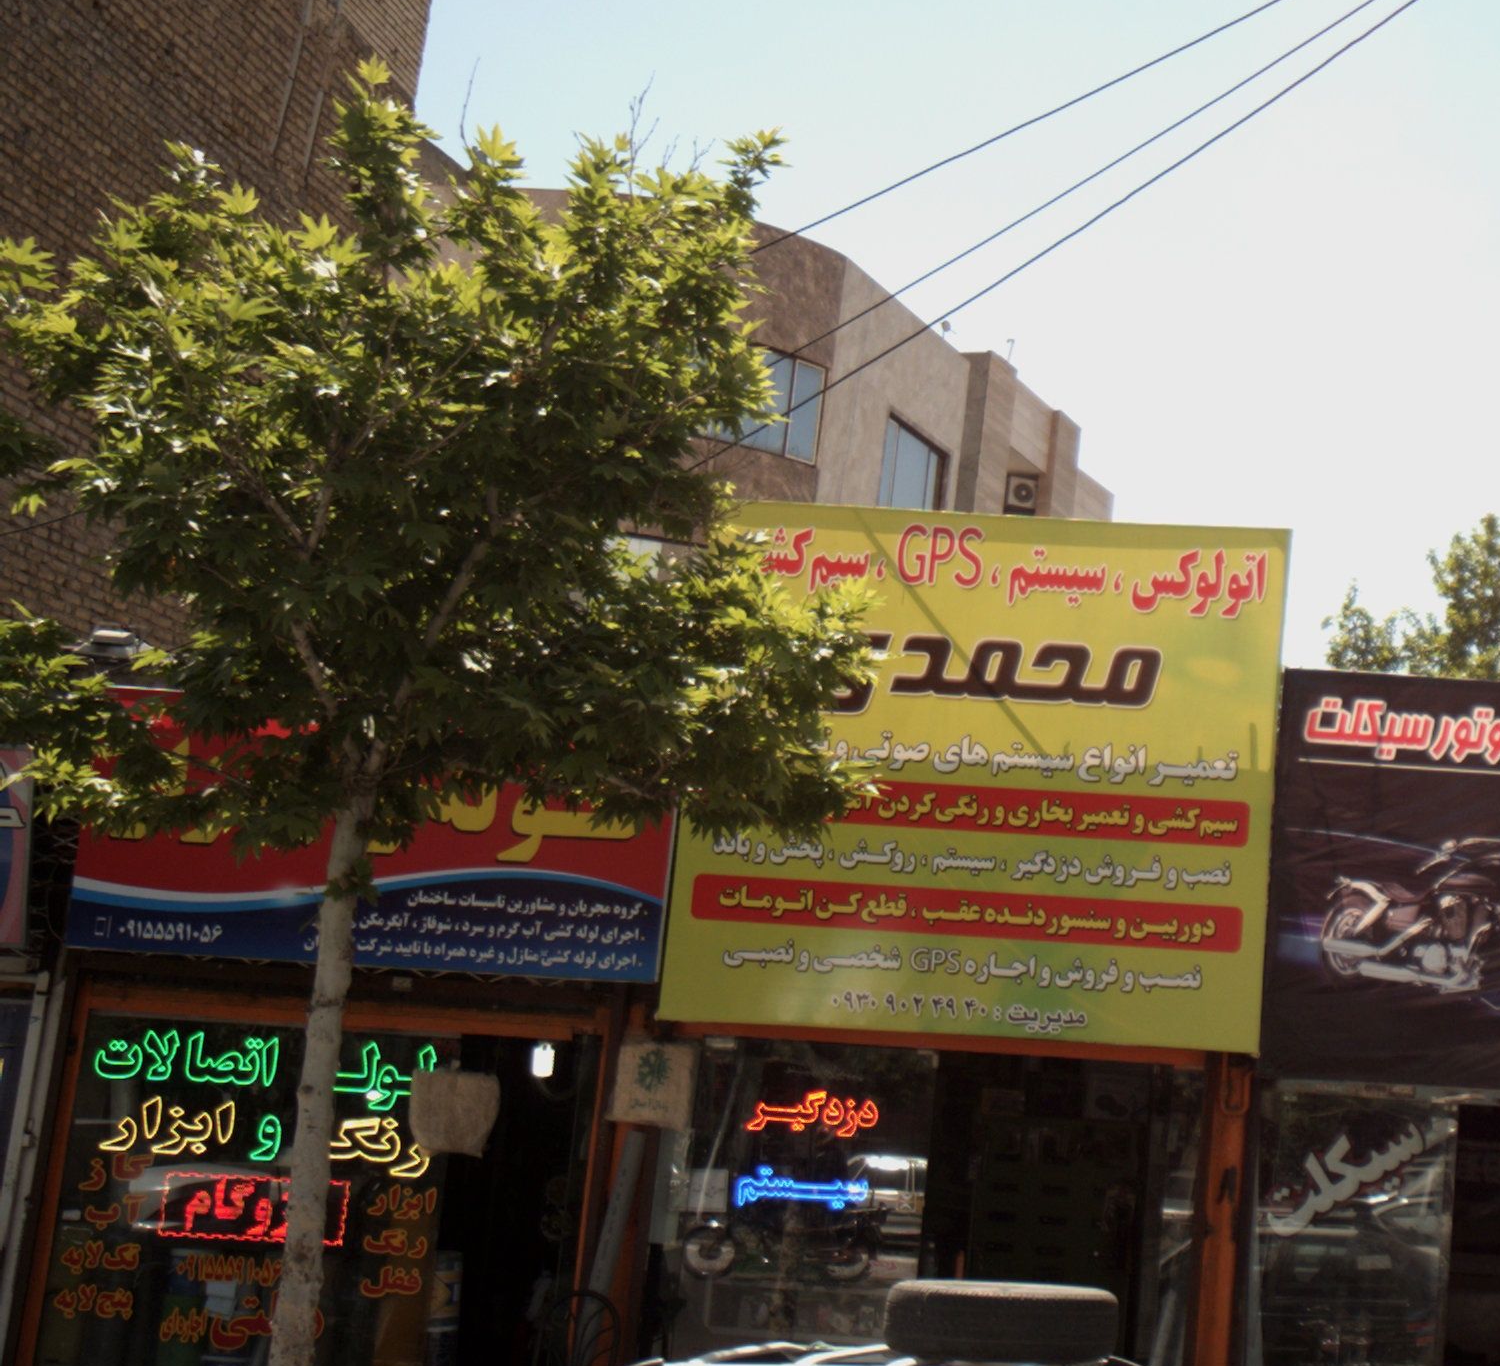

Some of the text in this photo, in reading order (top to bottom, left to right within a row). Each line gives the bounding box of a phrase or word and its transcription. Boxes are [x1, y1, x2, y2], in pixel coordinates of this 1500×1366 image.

[760, 525, 815, 577] کش
[809, 551, 870, 592] سیم
[1304, 695, 1434, 760] سیکلت
[933, 735, 989, 773] های
[991, 741, 1075, 778] سیستم
[1077, 743, 1147, 784] انواع
[1148, 750, 1239, 786] تعمیر
[877, 792, 936, 821] کردن
[934, 794, 989, 825] رنگی
[992, 804, 1005, 826] و
[1008, 799, 1074, 830] بخاری
[1076, 804, 1130, 831] تعمیر
[1132, 811, 1145, 834] و
[1148, 807, 1201, 835] کشی
[1199, 816, 1238, 838] سیم
[753, 840, 766, 864] و
[769, 836, 824, 867] پخش
[1084, 855, 1162, 887] فروش
[1164, 865, 1178, 888] و
[1182, 861, 1232, 889] نصب
[407, 889, 457, 907] ساختمان
[506, 896, 556, 914] مشاورین
[567, 899, 612, 917] مجریان
[614, 902, 643, 920] گروه
[719, 885, 814, 916] اتومات
[815, 892, 862, 919] کن
[860, 894, 907, 922] قطع
[984, 902, 1046, 927] دنده
[1045, 910, 1111, 935] سنسور
[1113, 917, 1127, 938] و
[497, 921, 521, 939] گرم
[522, 920, 542, 939] آب
[543, 924, 575, 942] کشی
[575, 925, 600, 944] لوله
[601, 926, 640, 945] اجرای
[1129, 916, 1216, 943] دوربین
[356, 938, 394, 956] شرکت
[434, 942, 467, 961] همراه
[469, 946, 495, 963] غیره
[506, 947, 539, 965] منازل
[573, 950, 597, 969] لوله
[598, 954, 637, 971] اجرای
[723, 939, 1202, 992] نصب و فروش و اجاره GPS شخصی و نصبی
[94, 1029, 280, 1087] اتصالات
[97, 1095, 236, 1156] ابزار
[746, 1090, 880, 1137] دزدگیر
[248, 1113, 283, 1162] و
[734, 1165, 869, 1209] سیستم
[1267, 1122, 1424, 1237] سیکلت
[368, 1184, 438, 1220] ابزار
[362, 1228, 427, 1259] رنگ
